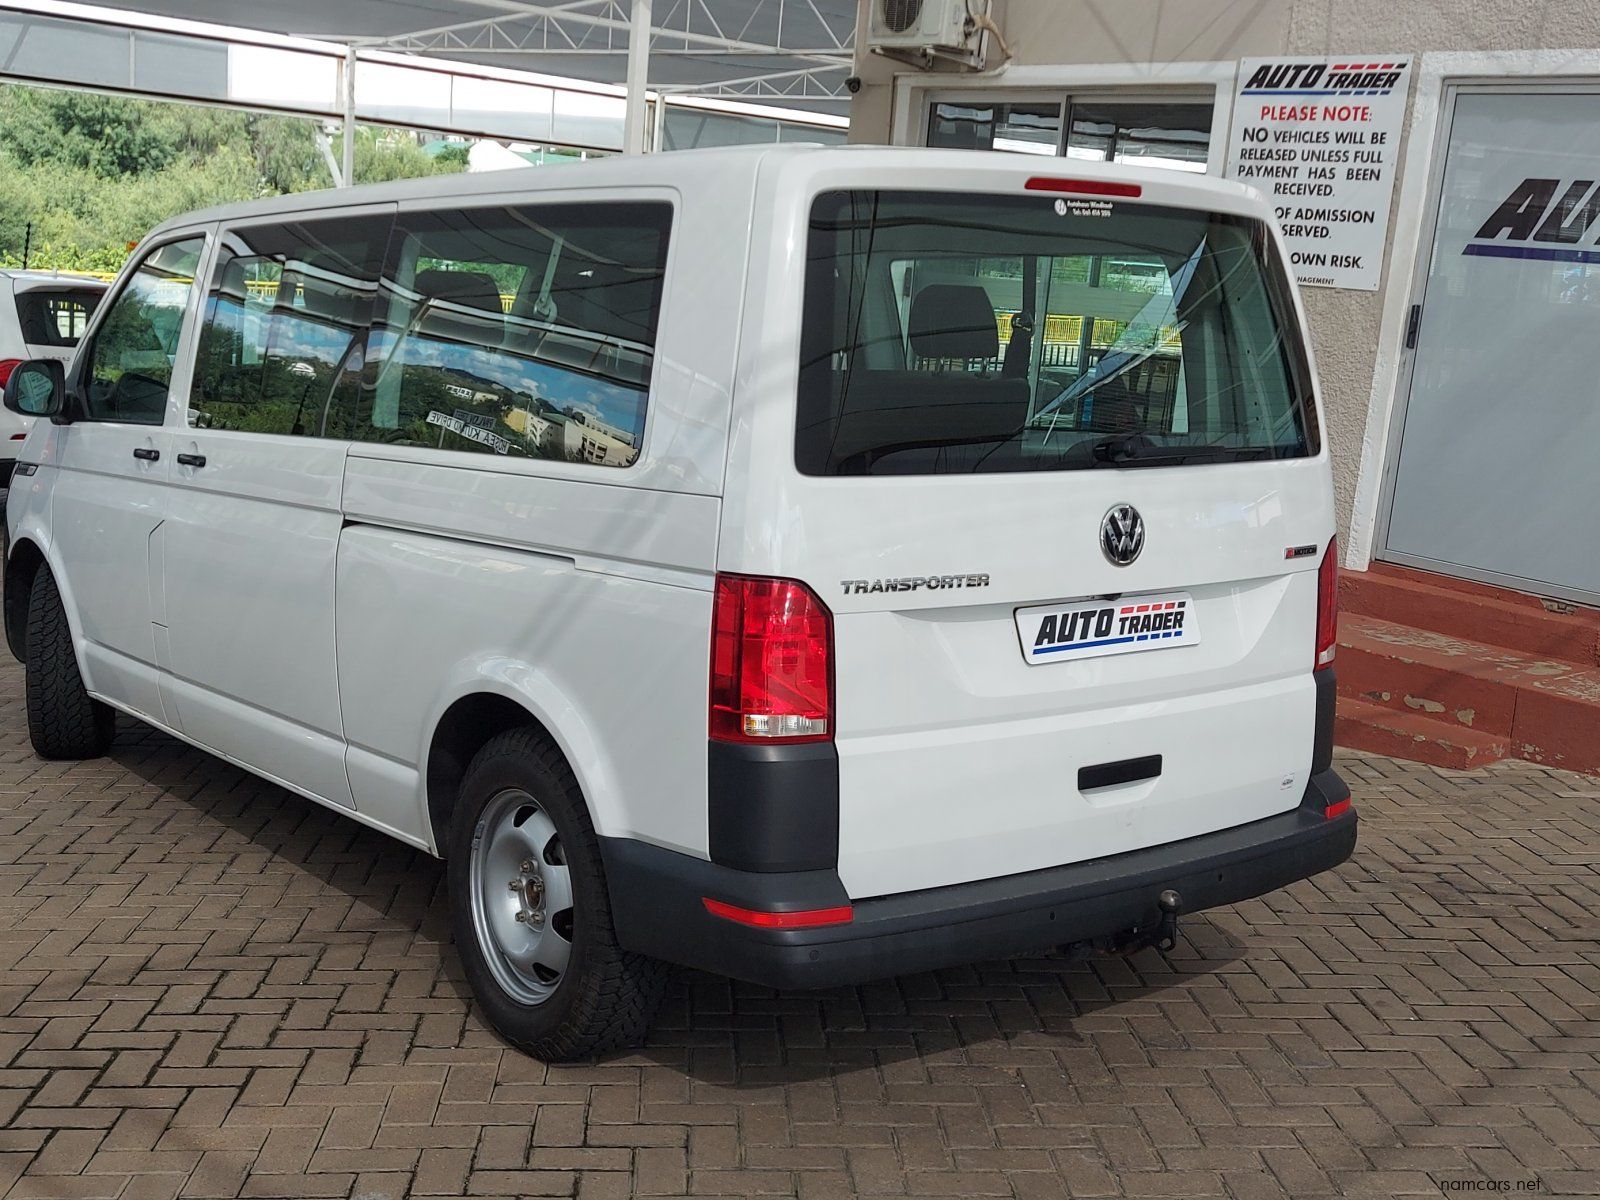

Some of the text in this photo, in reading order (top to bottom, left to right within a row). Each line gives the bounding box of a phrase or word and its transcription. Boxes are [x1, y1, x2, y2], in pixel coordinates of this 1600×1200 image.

[1245, 64, 1401, 89] AUTO TRADER
[1260, 105, 1373, 122] PLEASE NOTE:
[1242, 128, 1387, 145] NO VEHICLES WILL BE
[1240, 149, 1383, 163] RELEASED UNLESS FULL
[1238, 165, 1381, 181] PAYMENT HAS BEEN
[1273, 183, 1335, 197] RECEIVED.
[1274, 207, 1375, 223] OF ADMISSION
[1473, 178, 1600, 246] AU
[1281, 224, 1332, 239] SERVED.
[1291, 252, 1364, 269] OWN RISK.
[1297, 276, 1335, 285] NAGEMENT
[840, 573, 990, 595] TRANSPORTER
[1034, 608, 1185, 646] AUTO TRADER
